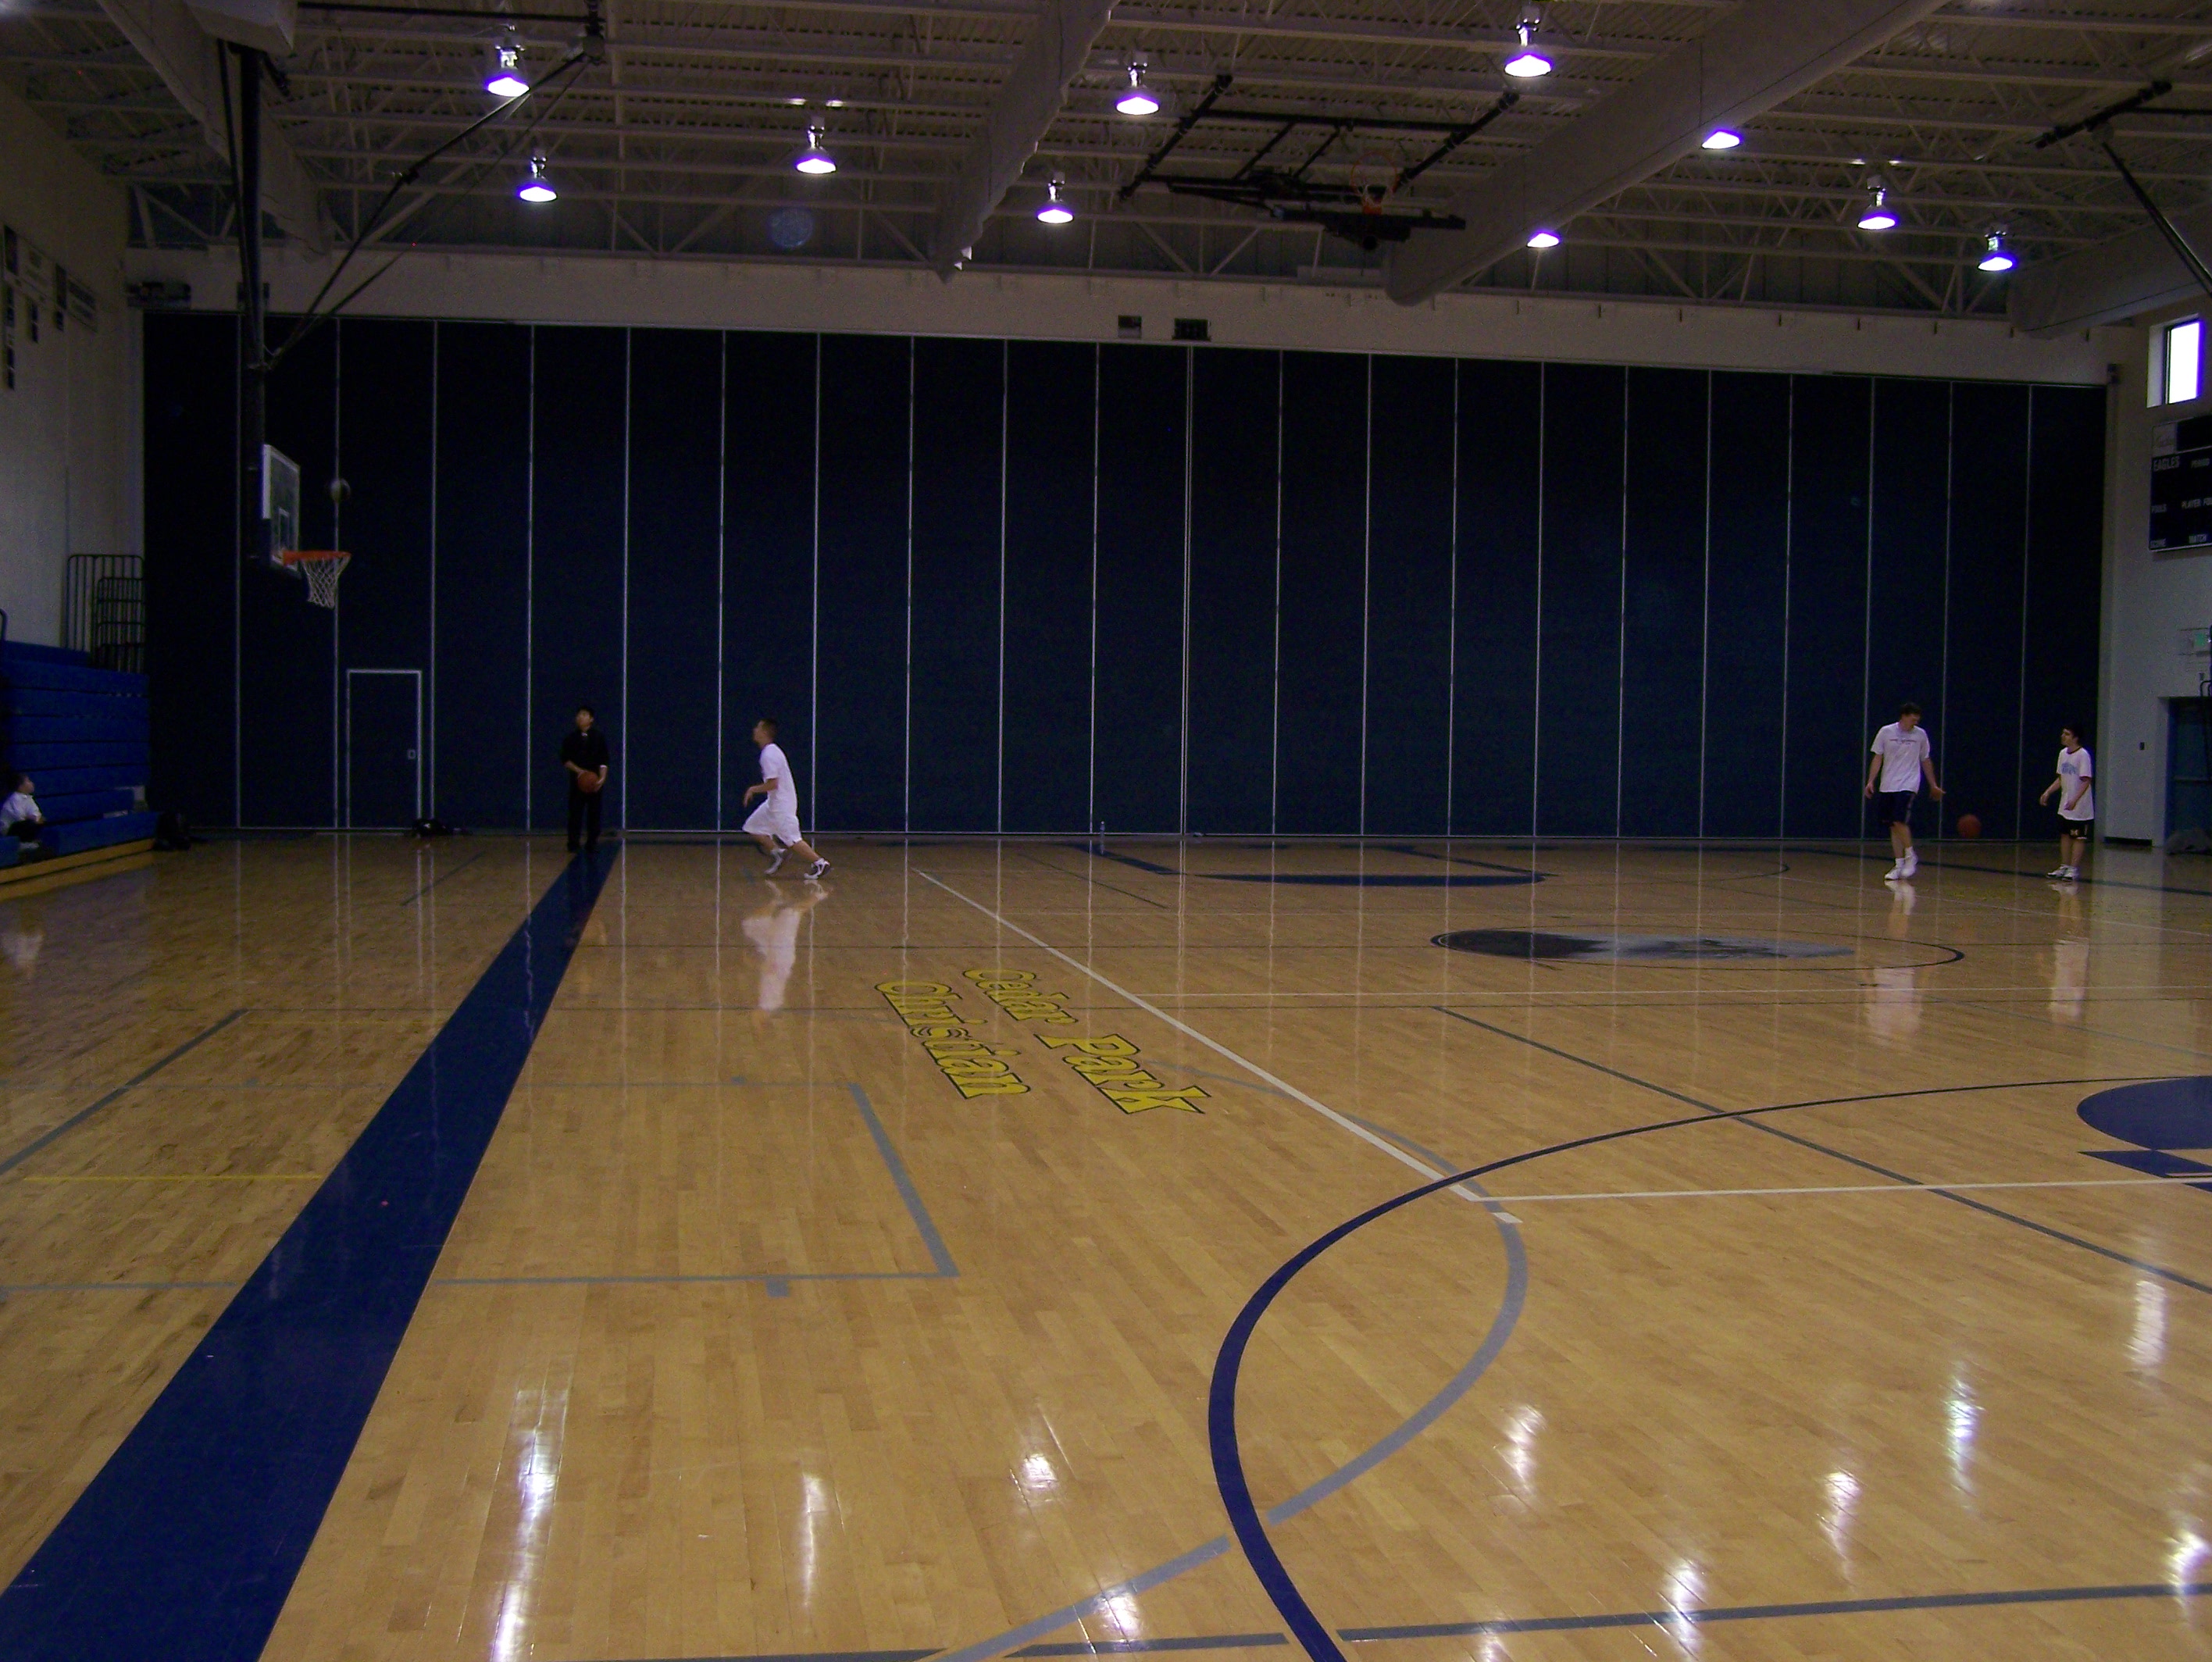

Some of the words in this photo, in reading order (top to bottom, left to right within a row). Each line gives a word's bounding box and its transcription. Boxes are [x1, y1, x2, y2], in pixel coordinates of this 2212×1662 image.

[2153, 455, 2180, 472] EAGLES
[874, 980, 1032, 1100] Christian
[962, 968, 1079, 1022] Cedar
[1034, 1033, 1213, 1115] Park
